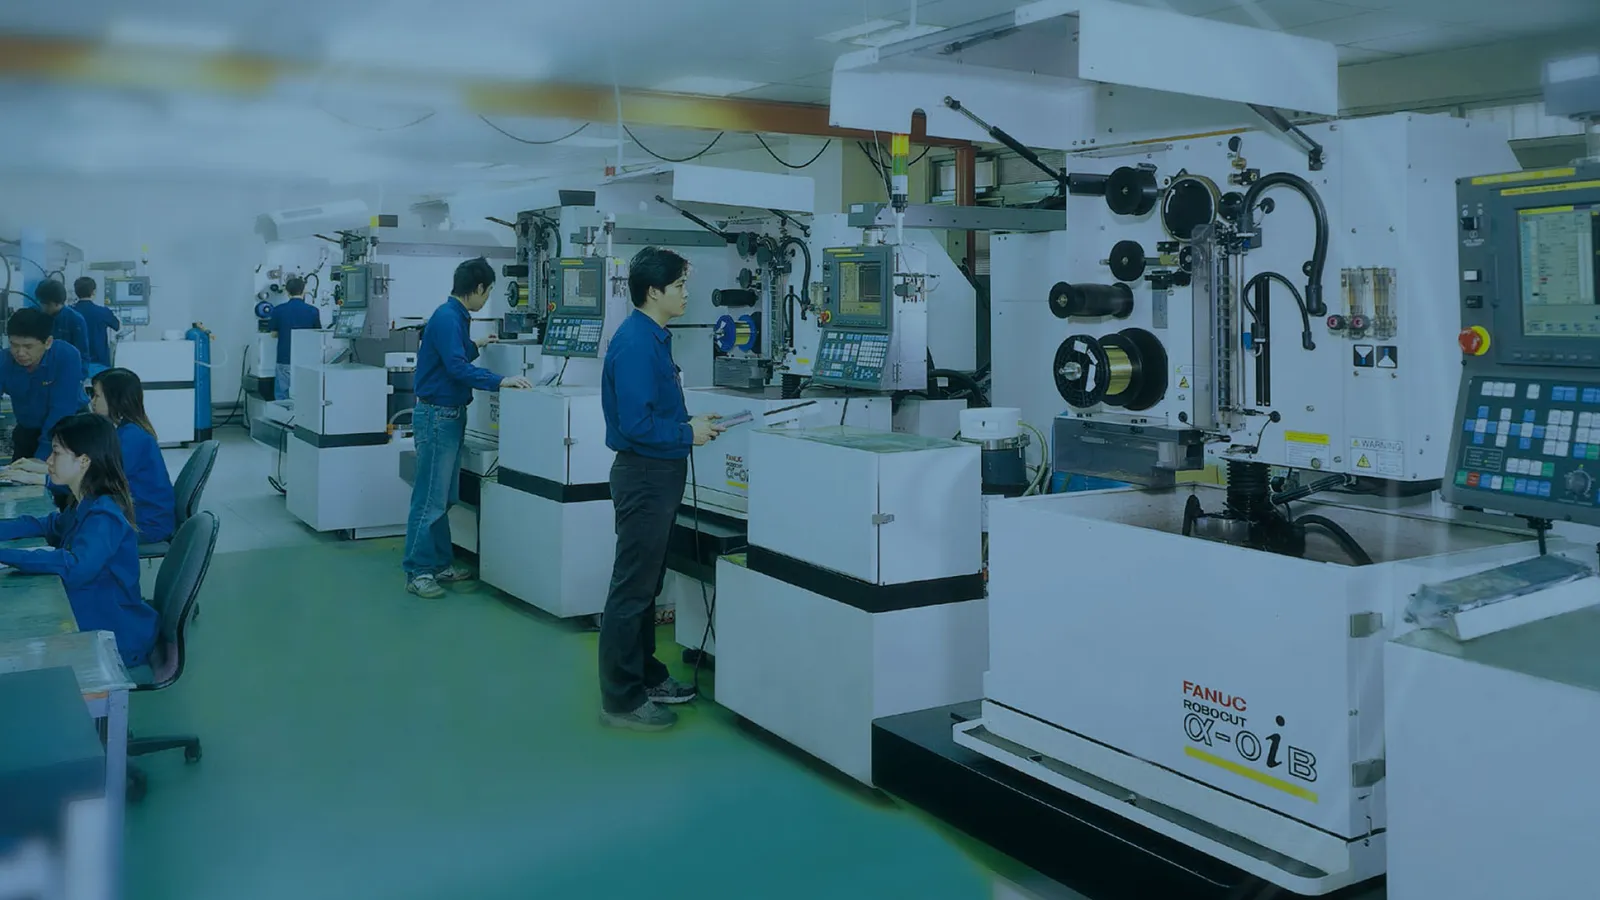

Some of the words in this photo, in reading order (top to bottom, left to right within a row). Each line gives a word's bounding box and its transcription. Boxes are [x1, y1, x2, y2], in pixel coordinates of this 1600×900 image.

[1361, 439, 1401, 451] WARNING
[1183, 680, 1247, 712] FANUC
[1183, 699, 1247, 727] ROBOCUT
